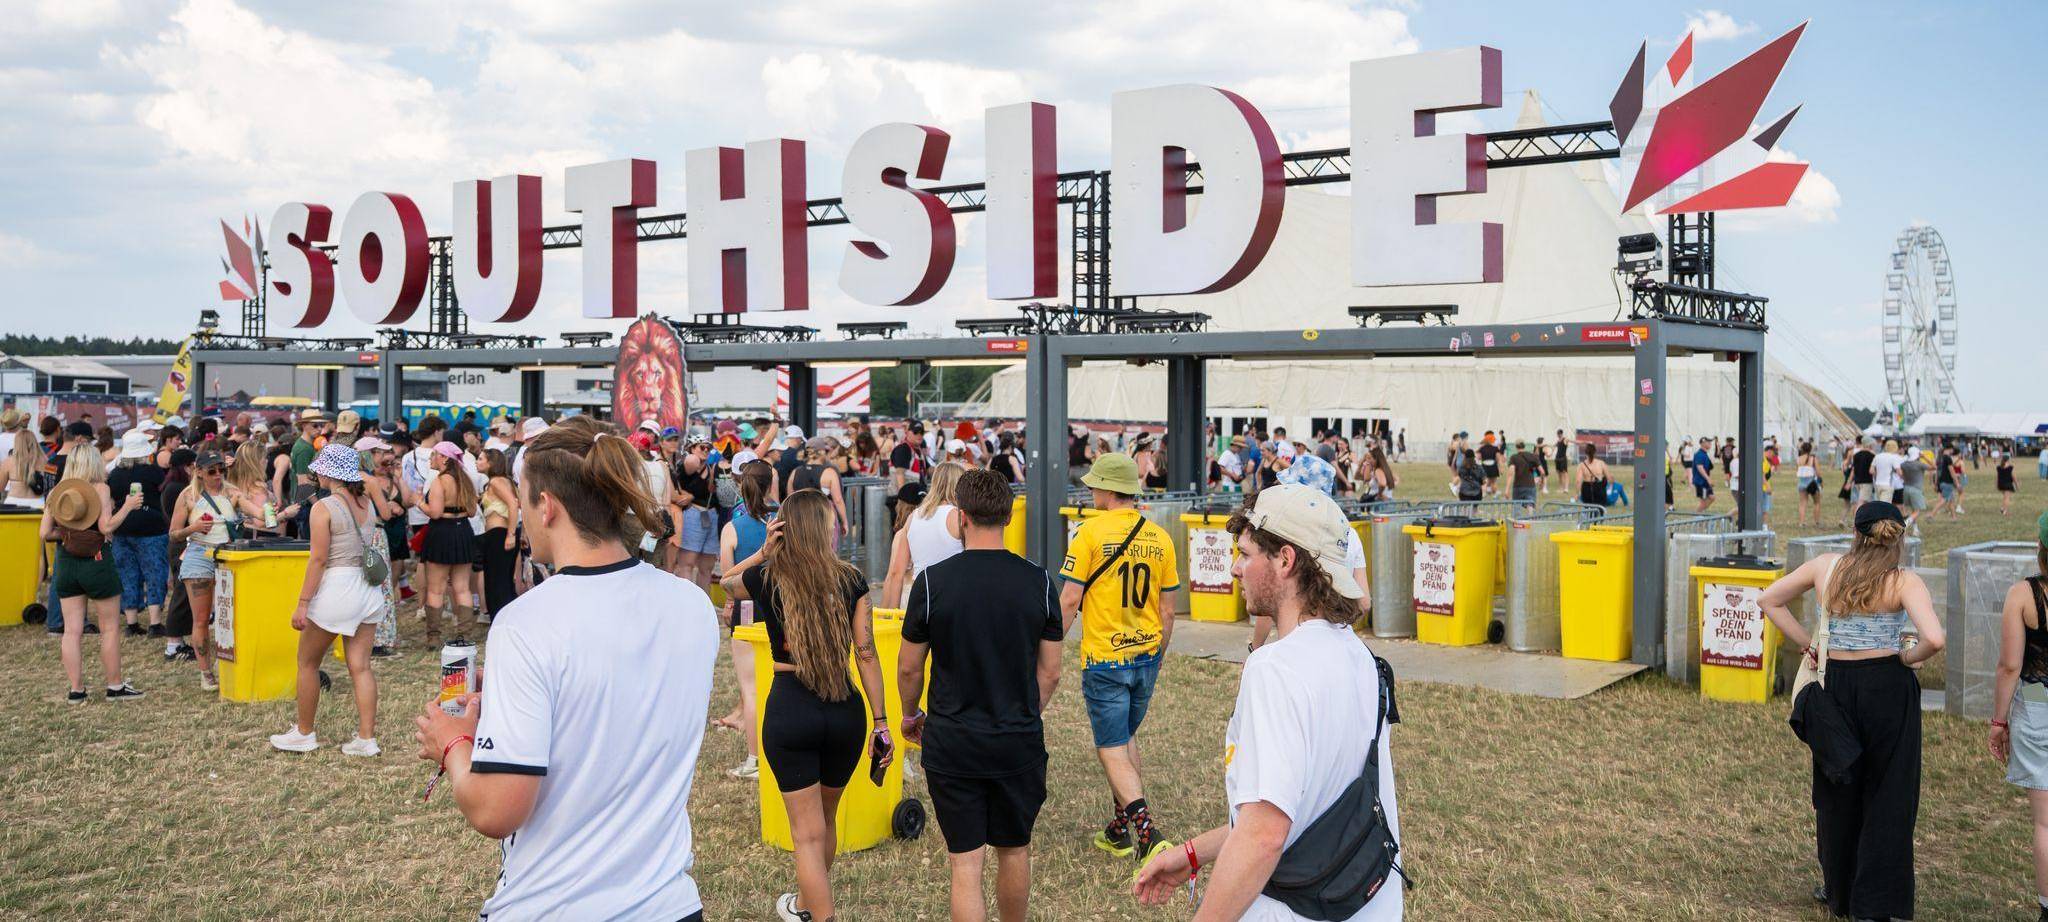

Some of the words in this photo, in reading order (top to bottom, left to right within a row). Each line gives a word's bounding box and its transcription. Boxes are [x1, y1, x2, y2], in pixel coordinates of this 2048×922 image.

[267, 45, 1503, 327] SOUTHSIDE
[1588, 330, 1625, 338] ZEPPELIN
[1196, 547, 1227, 558] SPENDE
[1202, 555, 1220, 564] DEIN
[1199, 563, 1225, 573] PFAND
[1419, 562, 1449, 575] SPENDE
[1425, 571, 1443, 582] DEIN
[1117, 561, 1151, 610] 10
[1422, 580, 1447, 591] PFAND
[1711, 607, 1755, 622] SPENDE
[1720, 619, 1746, 630] DEIN
[1715, 628, 1752, 641] PFAND
